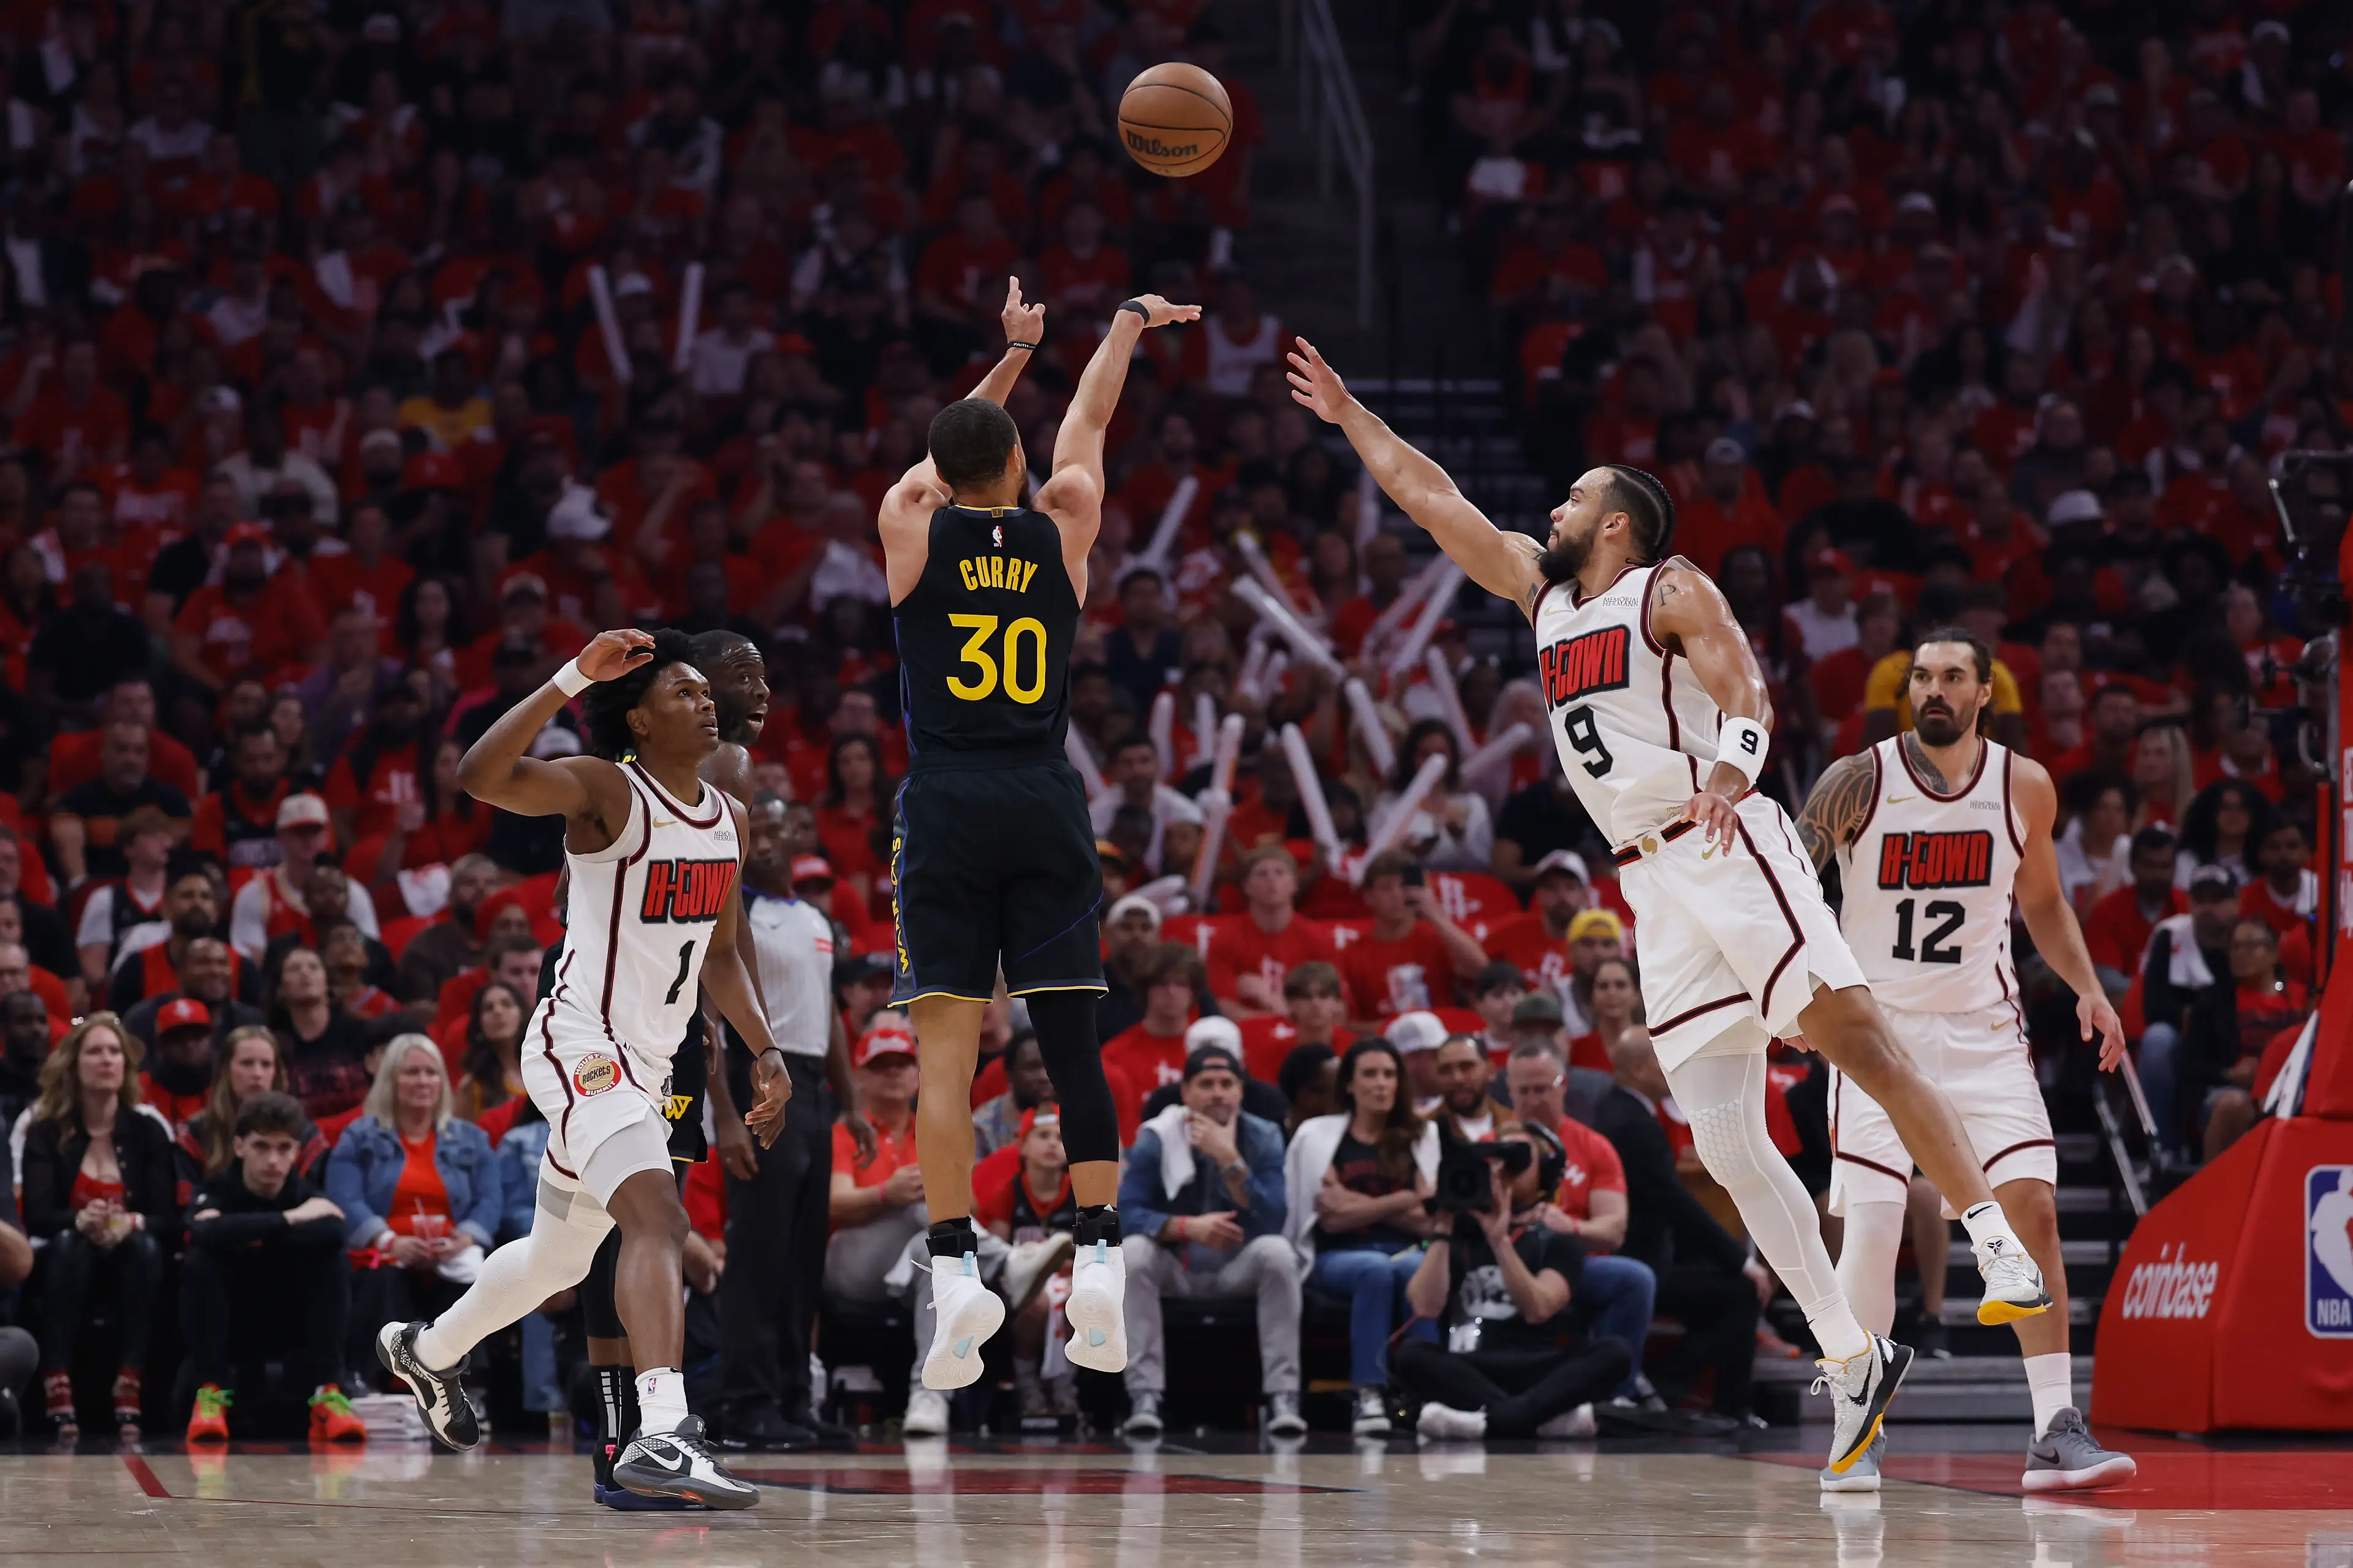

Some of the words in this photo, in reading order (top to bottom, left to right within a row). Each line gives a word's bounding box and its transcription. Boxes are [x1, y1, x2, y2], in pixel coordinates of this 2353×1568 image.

[1126, 129, 1198, 157] Wilson
[959, 556, 1038, 593] CURRY
[946, 613, 1047, 704] 30
[1564, 705, 1613, 779] 9
[1740, 729, 1759, 756] 9
[1892, 898, 1966, 964] 12
[664, 939, 696, 1006] 1
[575, 1054, 612, 1075] HOUSTON
[585, 1080, 616, 1096] SUMMIT
[2122, 1241, 2219, 1319] coinbase
[2316, 1298, 2351, 1327] NBA
